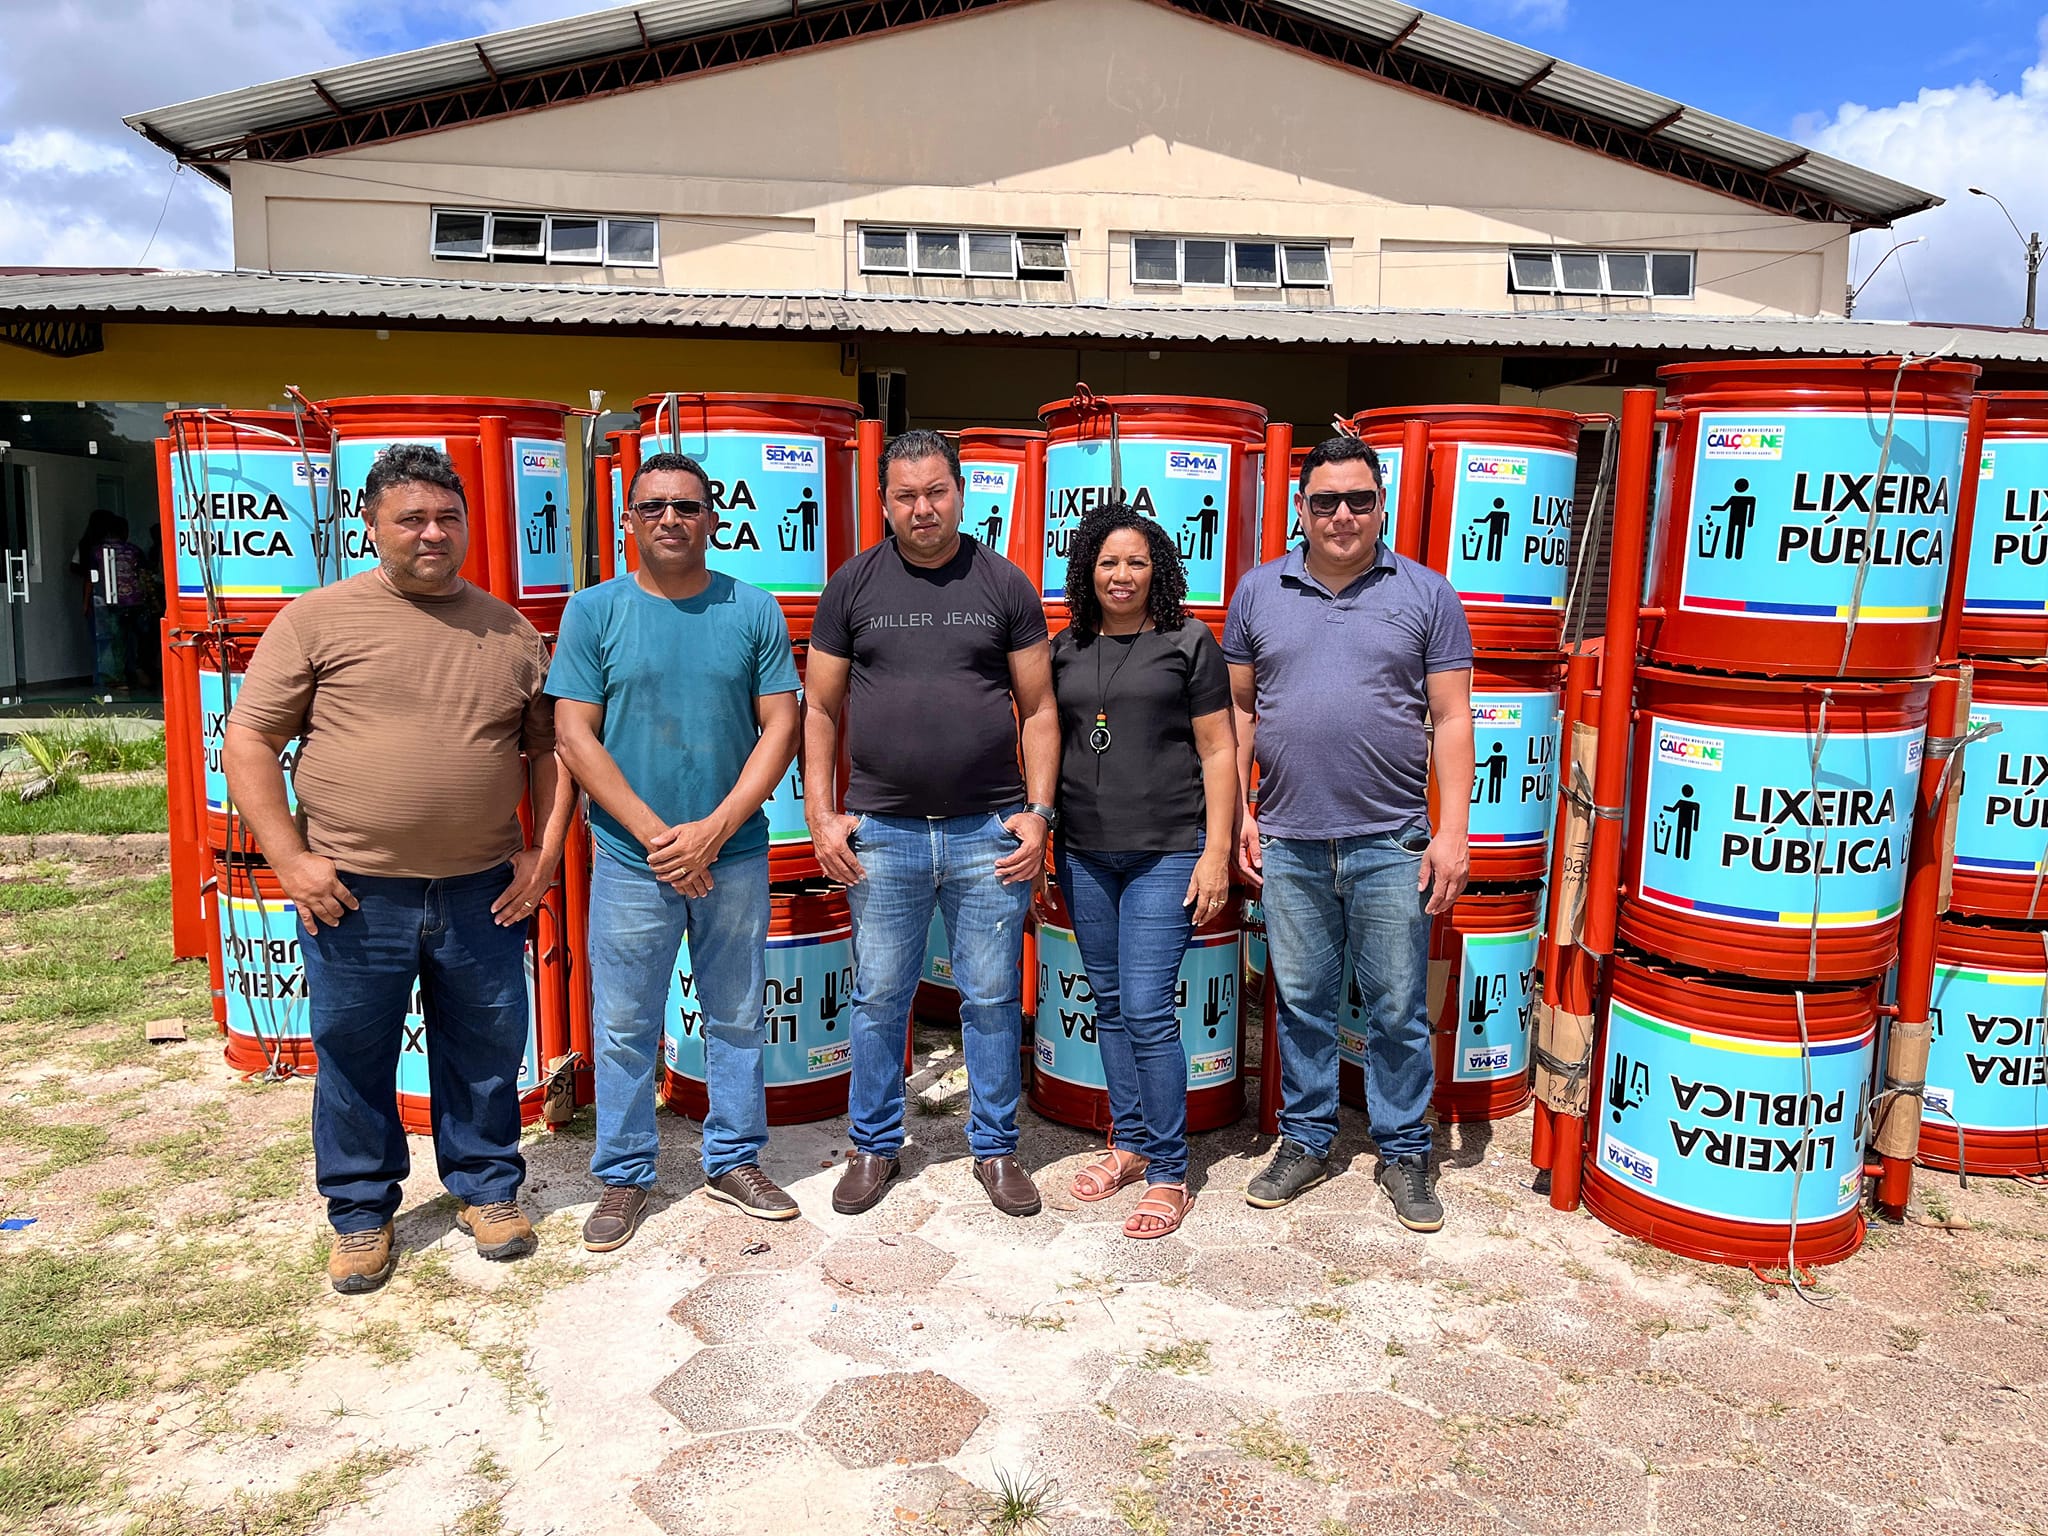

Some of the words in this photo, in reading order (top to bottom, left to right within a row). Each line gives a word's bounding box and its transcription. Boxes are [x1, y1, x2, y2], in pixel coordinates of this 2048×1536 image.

[1707, 434, 1783, 450] CALÇOENE
[766, 449, 813, 463] SEMMA
[1170, 455, 1217, 470] SEMMA
[972, 474, 1004, 486] SEMMA
[1793, 473, 1949, 515] LIXEIRA
[1777, 514, 1943, 566] PÚBLICA
[870, 613, 934, 629] MILLER
[943, 612, 997, 628] JEANS
[1660, 739, 1722, 760] CALÇOENE
[1732, 785, 1896, 826] LIXEIRA
[1721, 826, 1892, 874] PÚBLICA
[1469, 1053, 1508, 1068] SEMMA
[1669, 1076, 1844, 1136] PÚBLICA
[1669, 1121, 1834, 1172] LIXEIRA
[1607, 1147, 1653, 1180] SEMMA
